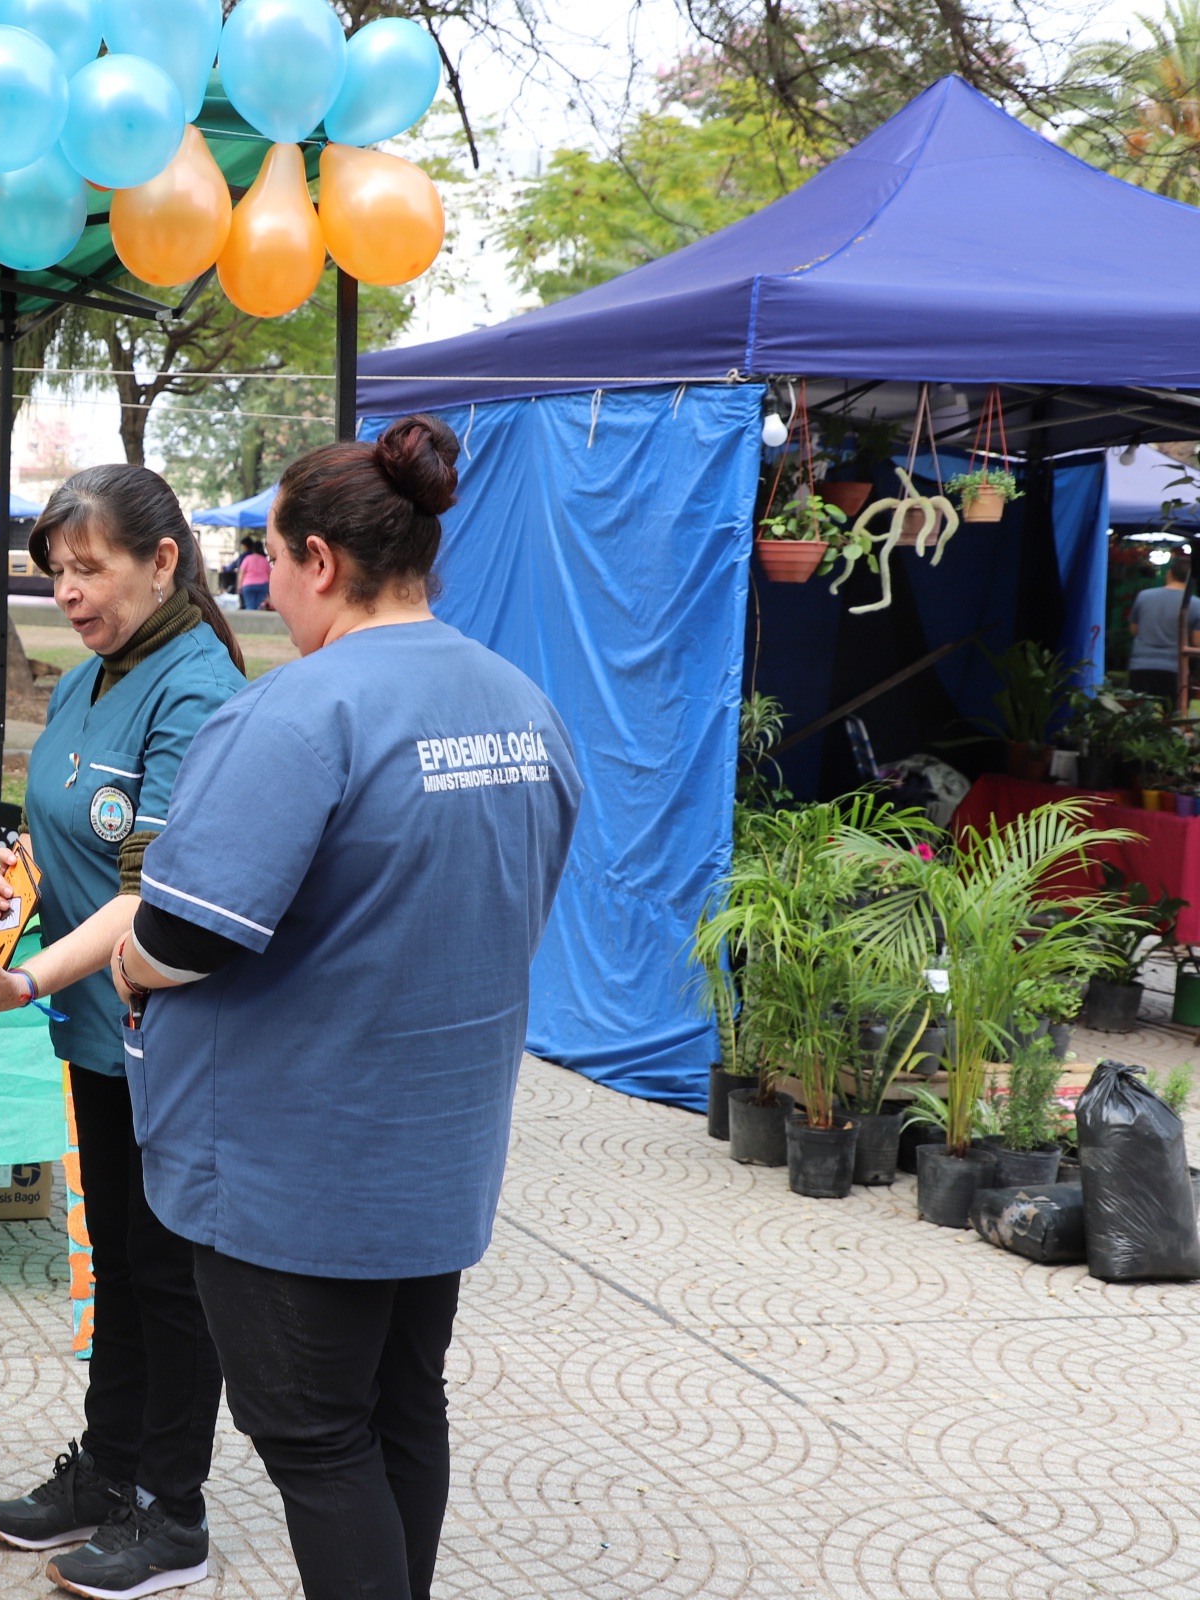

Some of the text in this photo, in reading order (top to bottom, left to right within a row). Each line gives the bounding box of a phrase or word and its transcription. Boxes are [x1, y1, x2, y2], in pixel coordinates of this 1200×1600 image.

[416, 720, 549, 772] EPIDEMIOLOGÍA
[423, 769, 481, 793] MINISTERIO
[14, 1191, 40, 1204] Bagó
